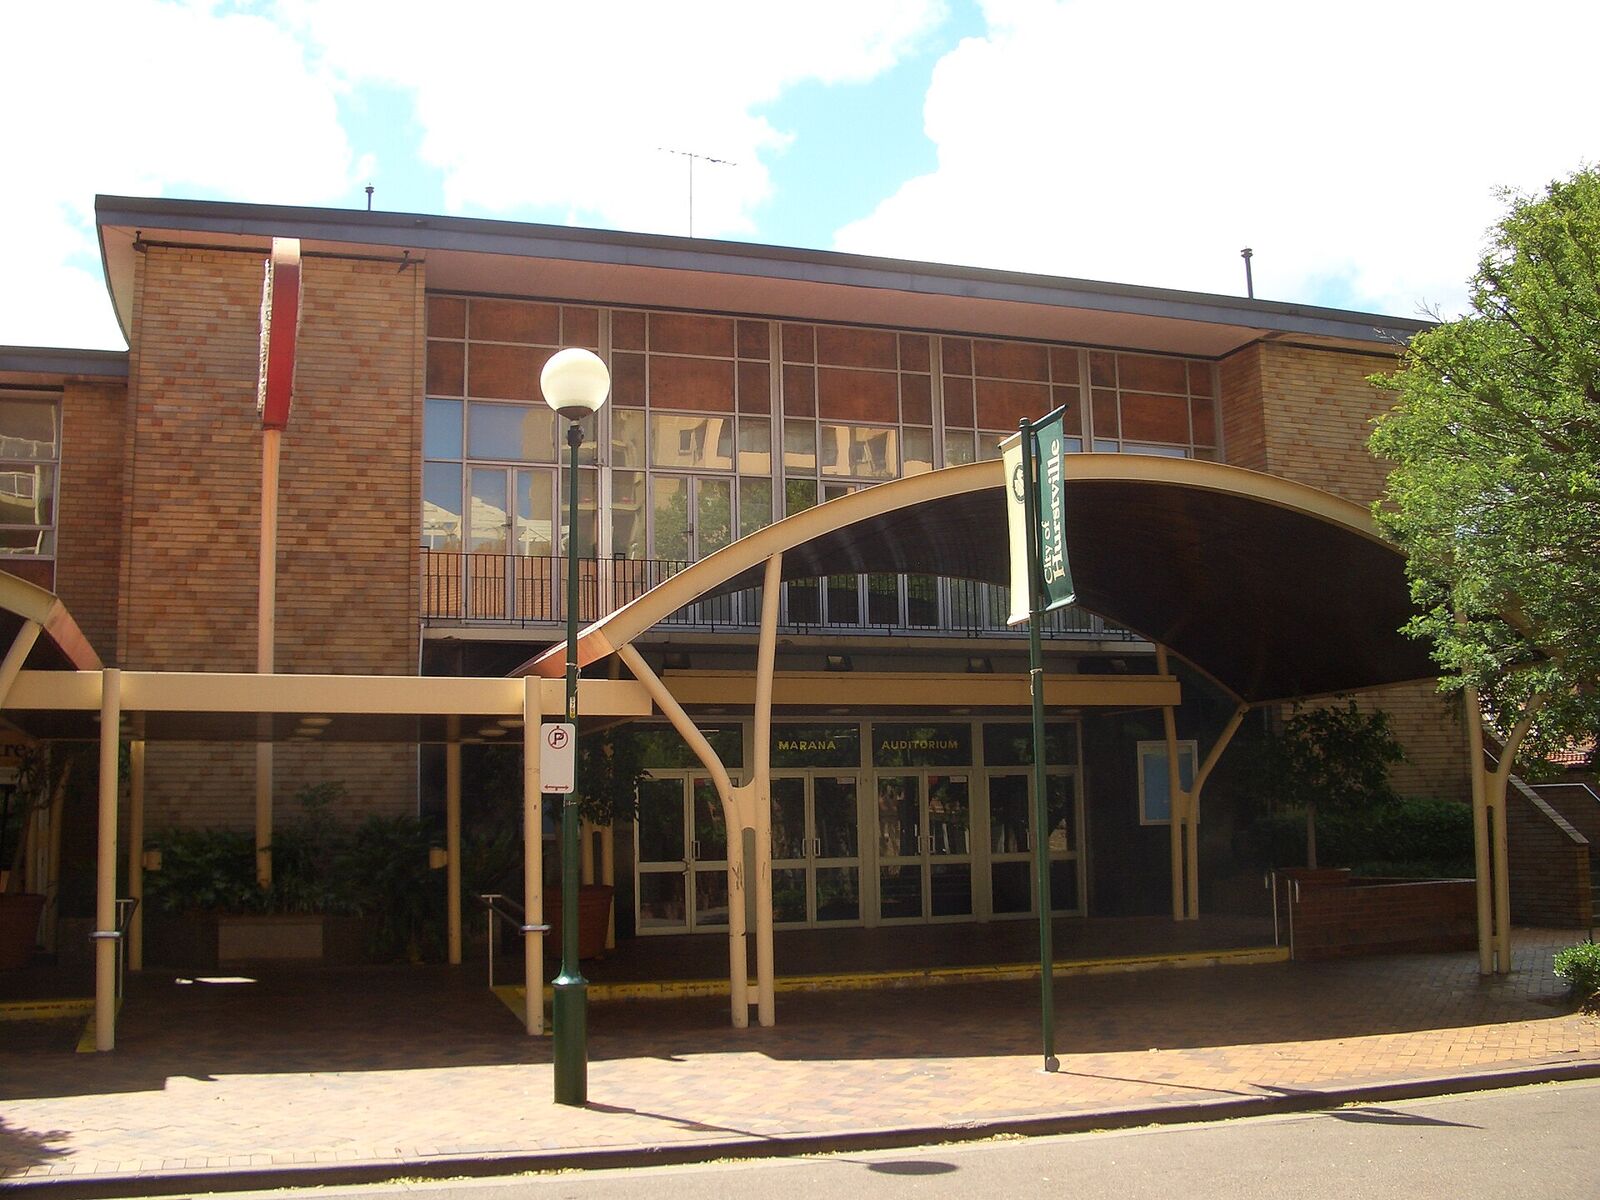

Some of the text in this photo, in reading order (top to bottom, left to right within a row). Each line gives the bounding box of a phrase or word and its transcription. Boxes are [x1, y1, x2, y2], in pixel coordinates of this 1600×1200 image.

[1047, 438, 1065, 581] Hurstville
[1041, 520, 1053, 585] City of
[0, 743, 26, 758] re
[778, 740, 959, 750] MARANA AUDITORIUM
